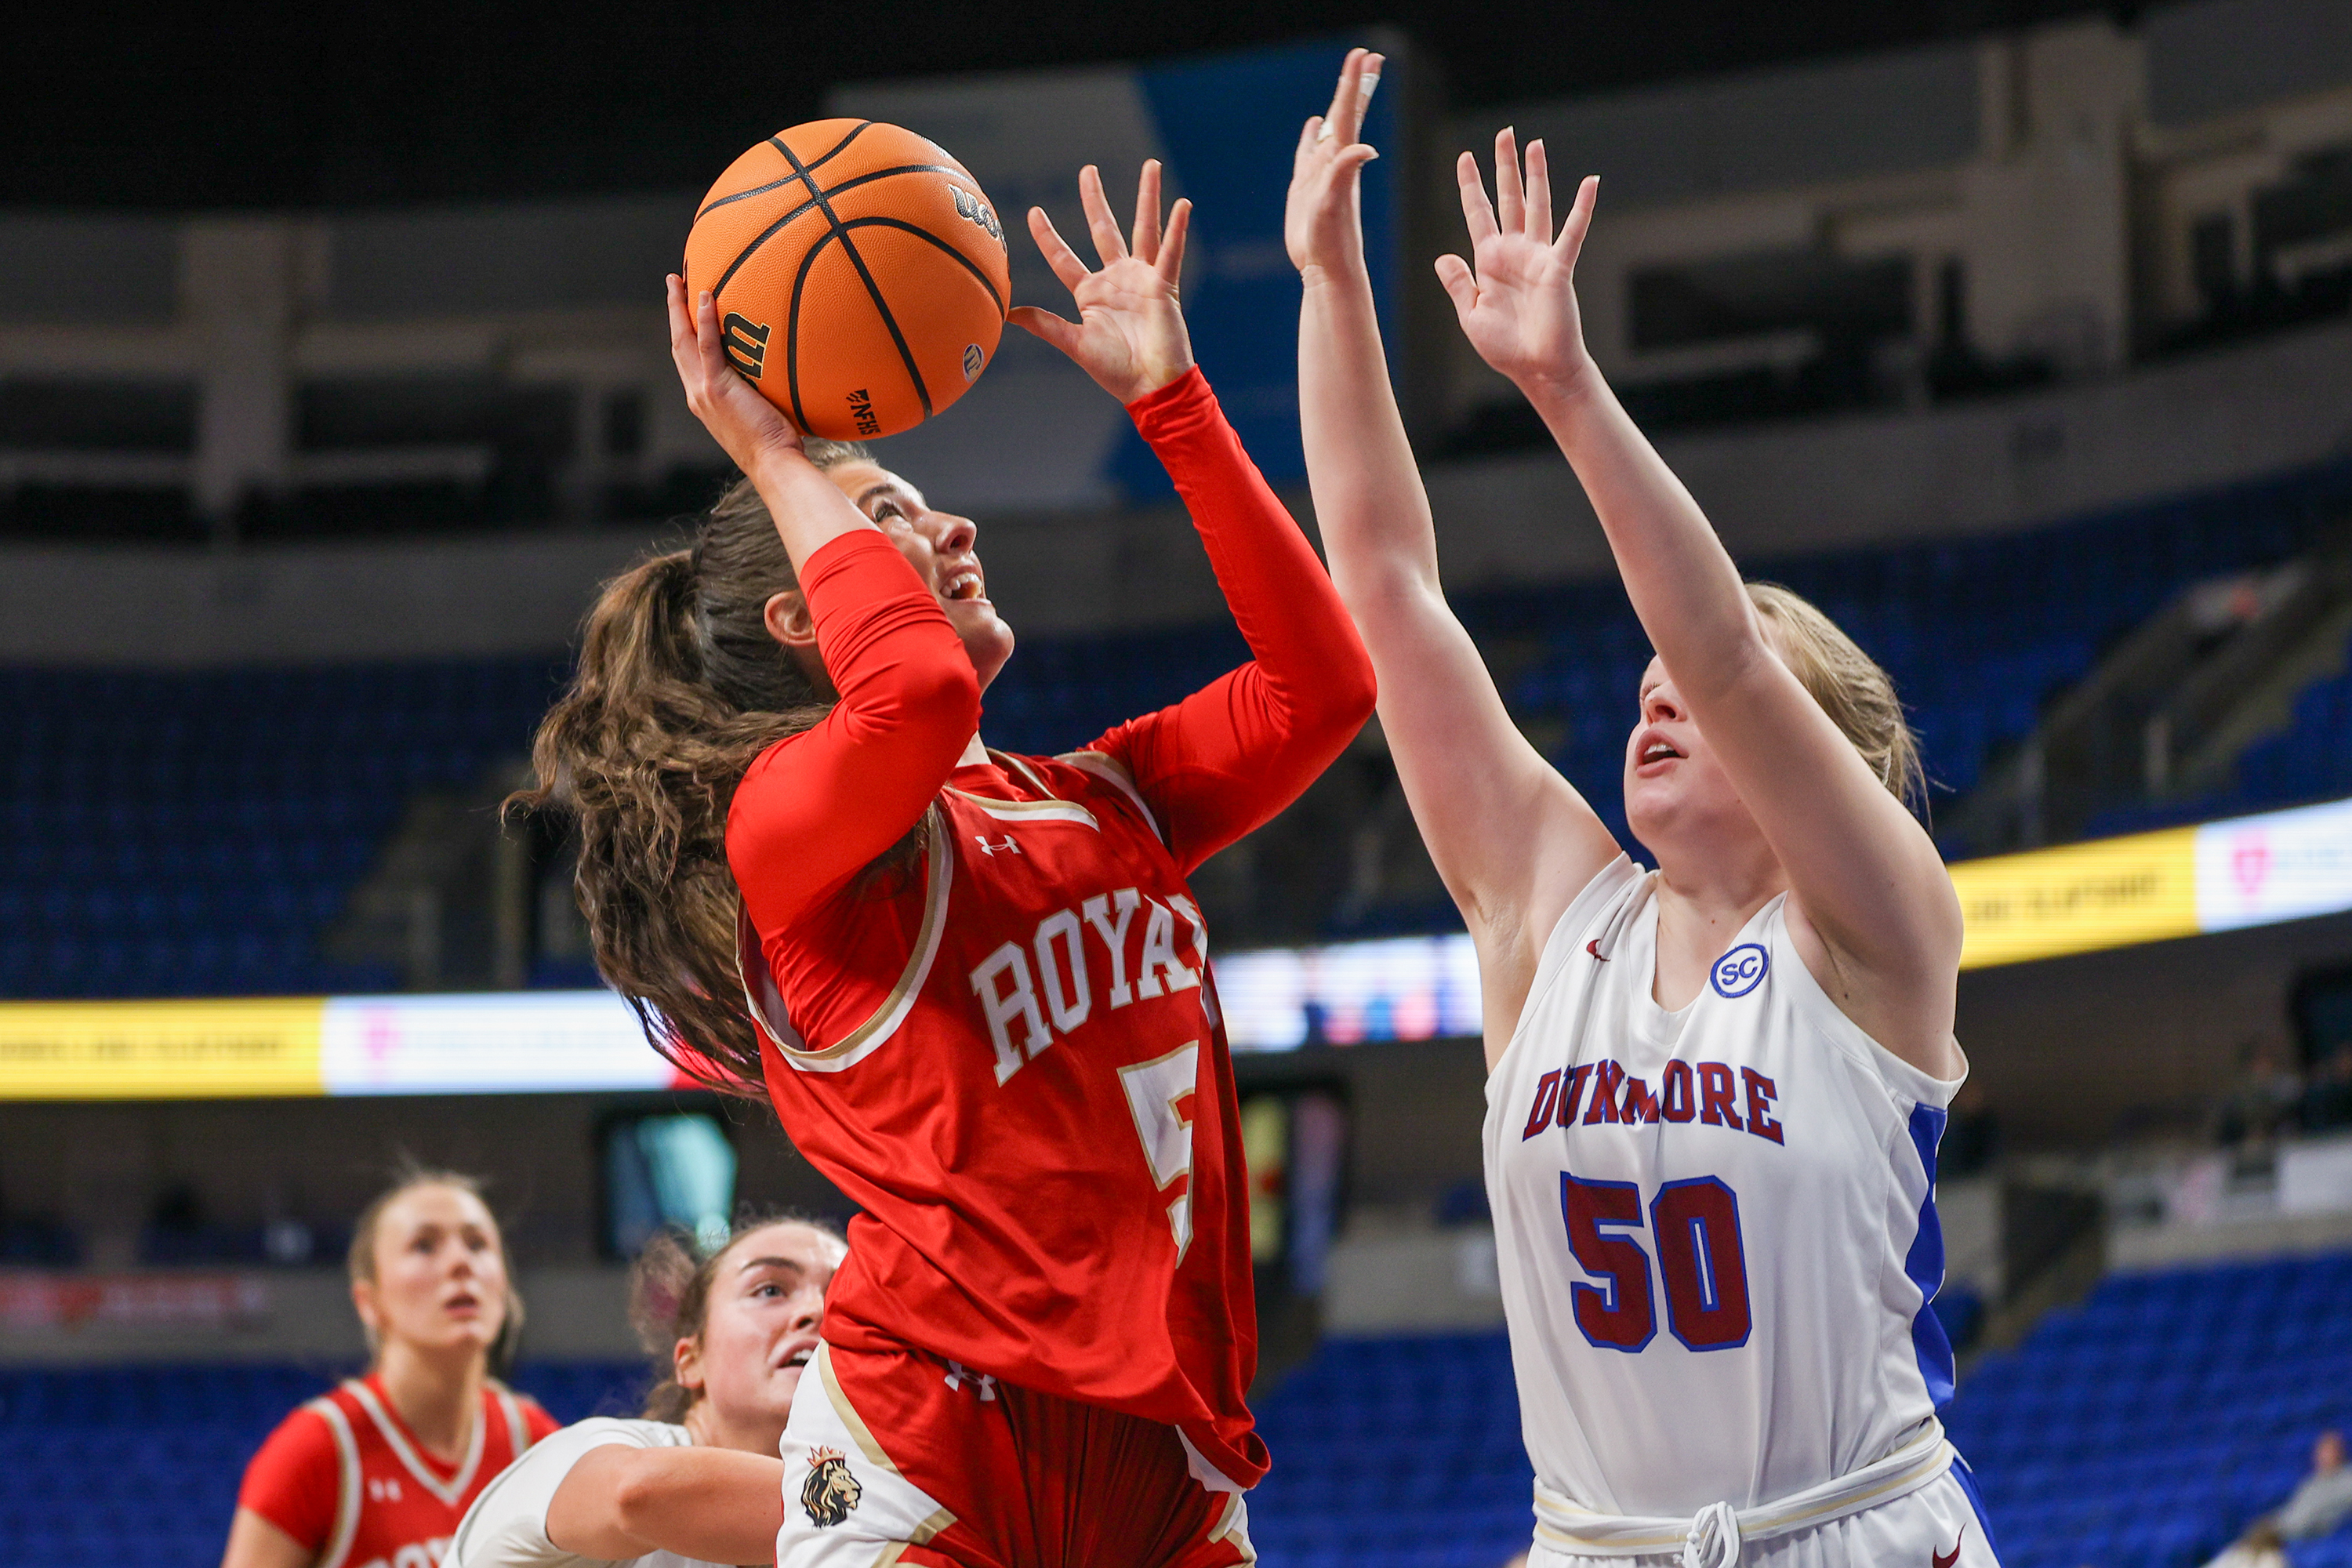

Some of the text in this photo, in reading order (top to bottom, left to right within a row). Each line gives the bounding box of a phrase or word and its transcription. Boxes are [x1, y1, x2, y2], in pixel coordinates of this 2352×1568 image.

[851, 402, 880, 435] NFHS
[1721, 956, 1758, 985] SC
[1522, 1058, 1785, 1147] DUNMORE
[1559, 1171, 1753, 1353] 50
